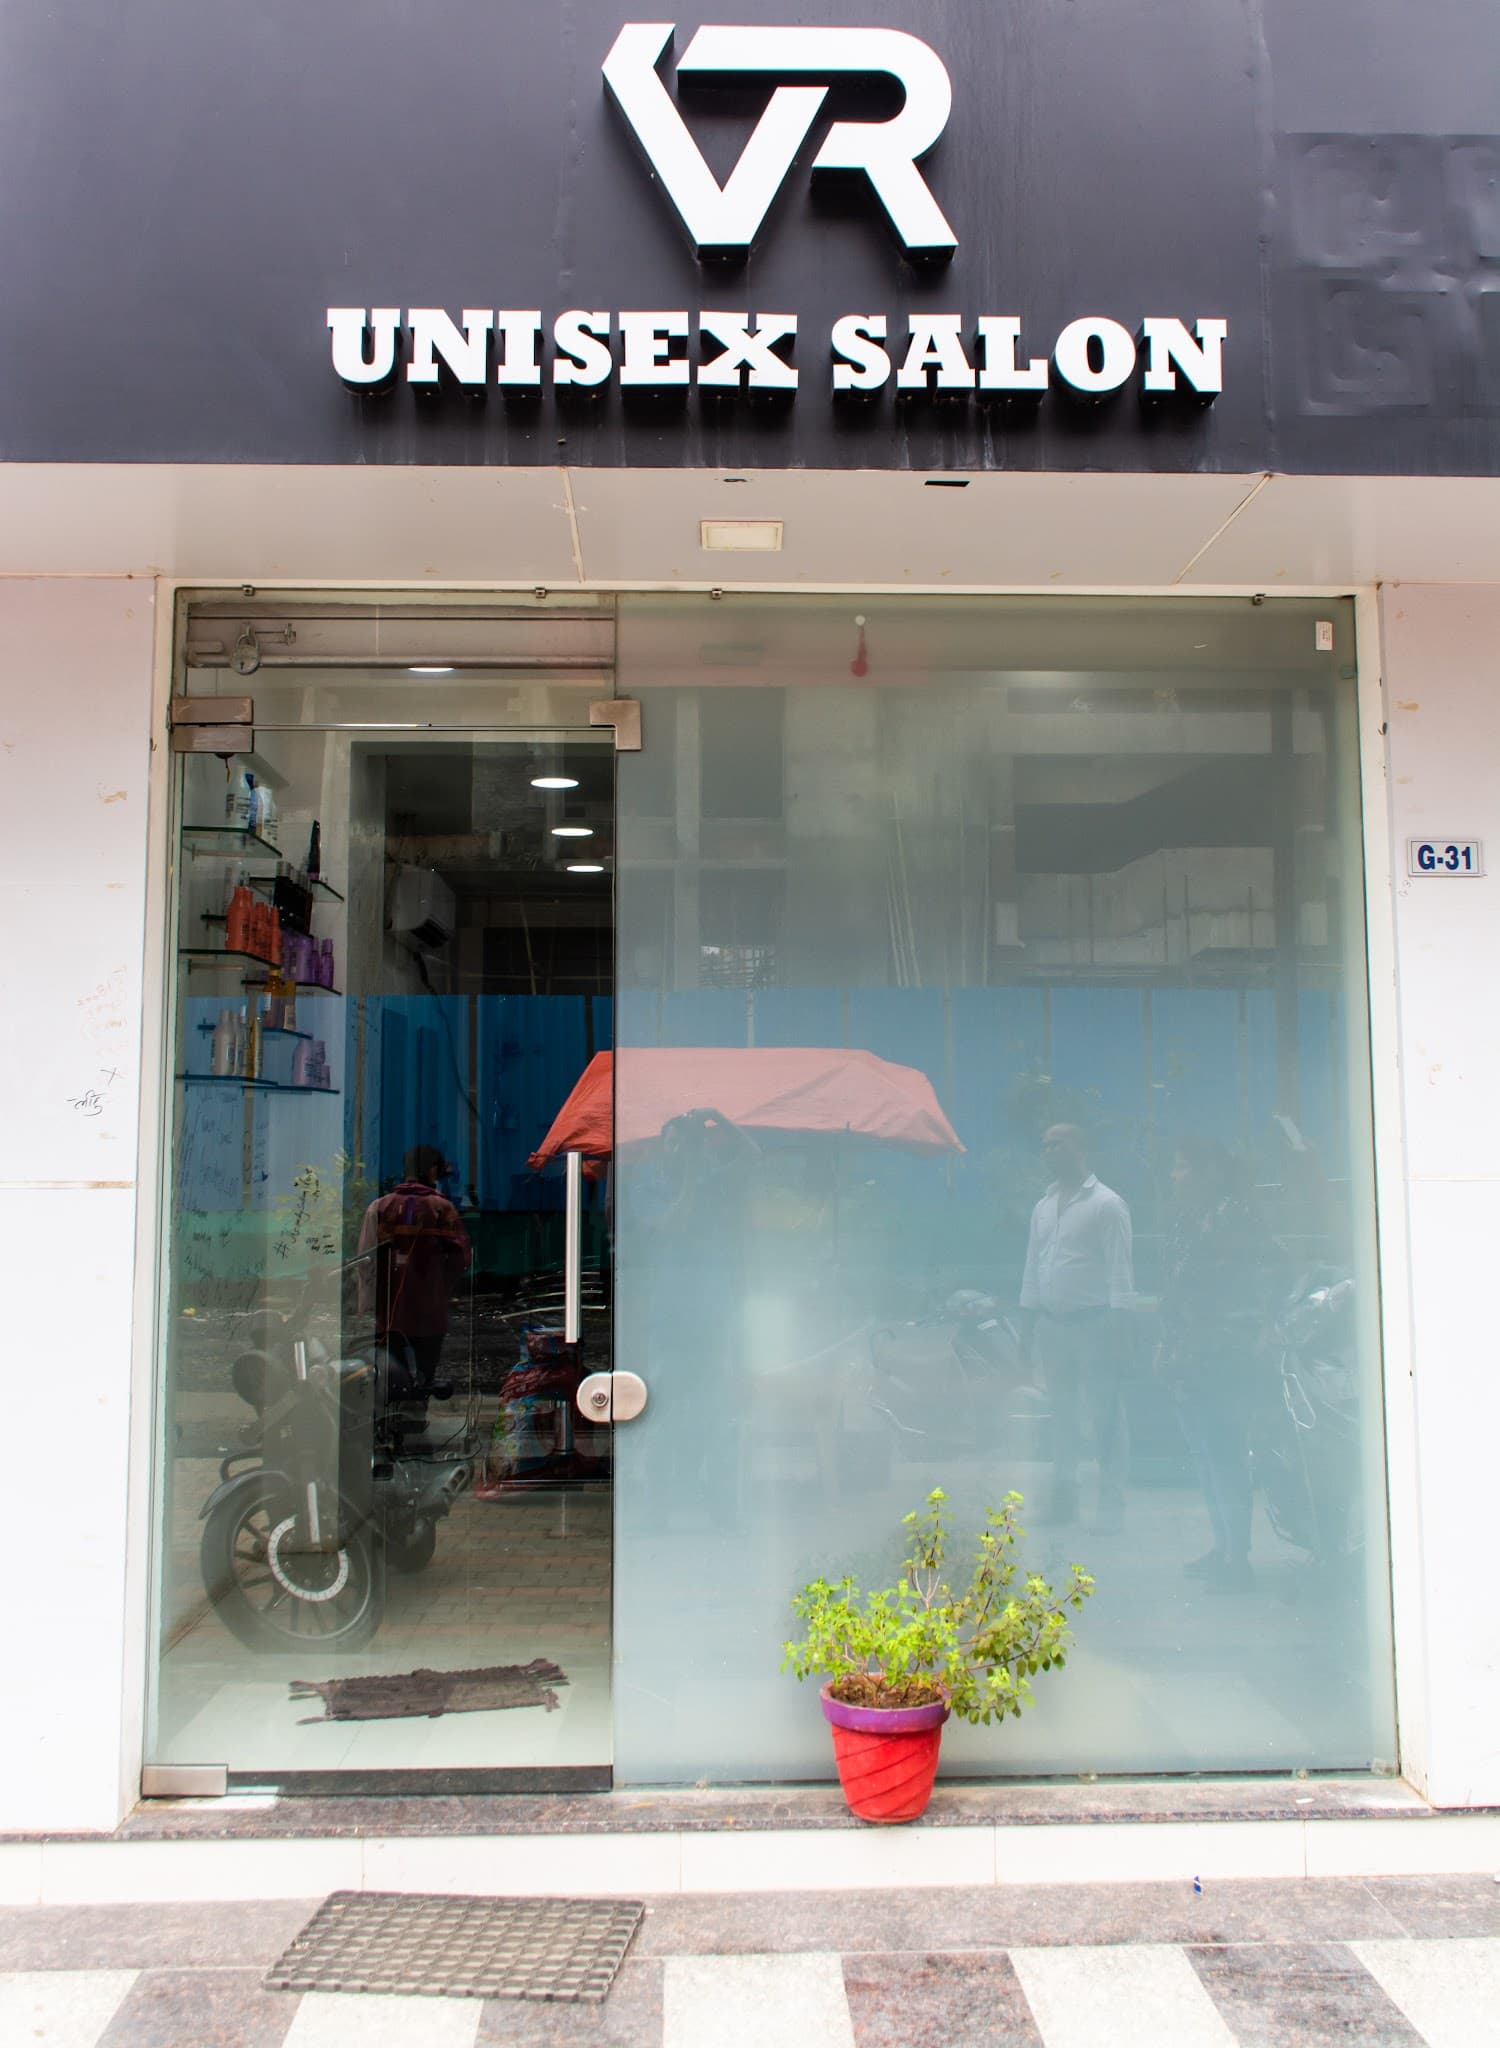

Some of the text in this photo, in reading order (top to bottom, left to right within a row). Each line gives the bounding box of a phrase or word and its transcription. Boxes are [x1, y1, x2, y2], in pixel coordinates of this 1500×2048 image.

[601, 22, 959, 248] VR
[326, 307, 1228, 394] UNISEX SALON
[1417, 844, 1472, 871] G-31
